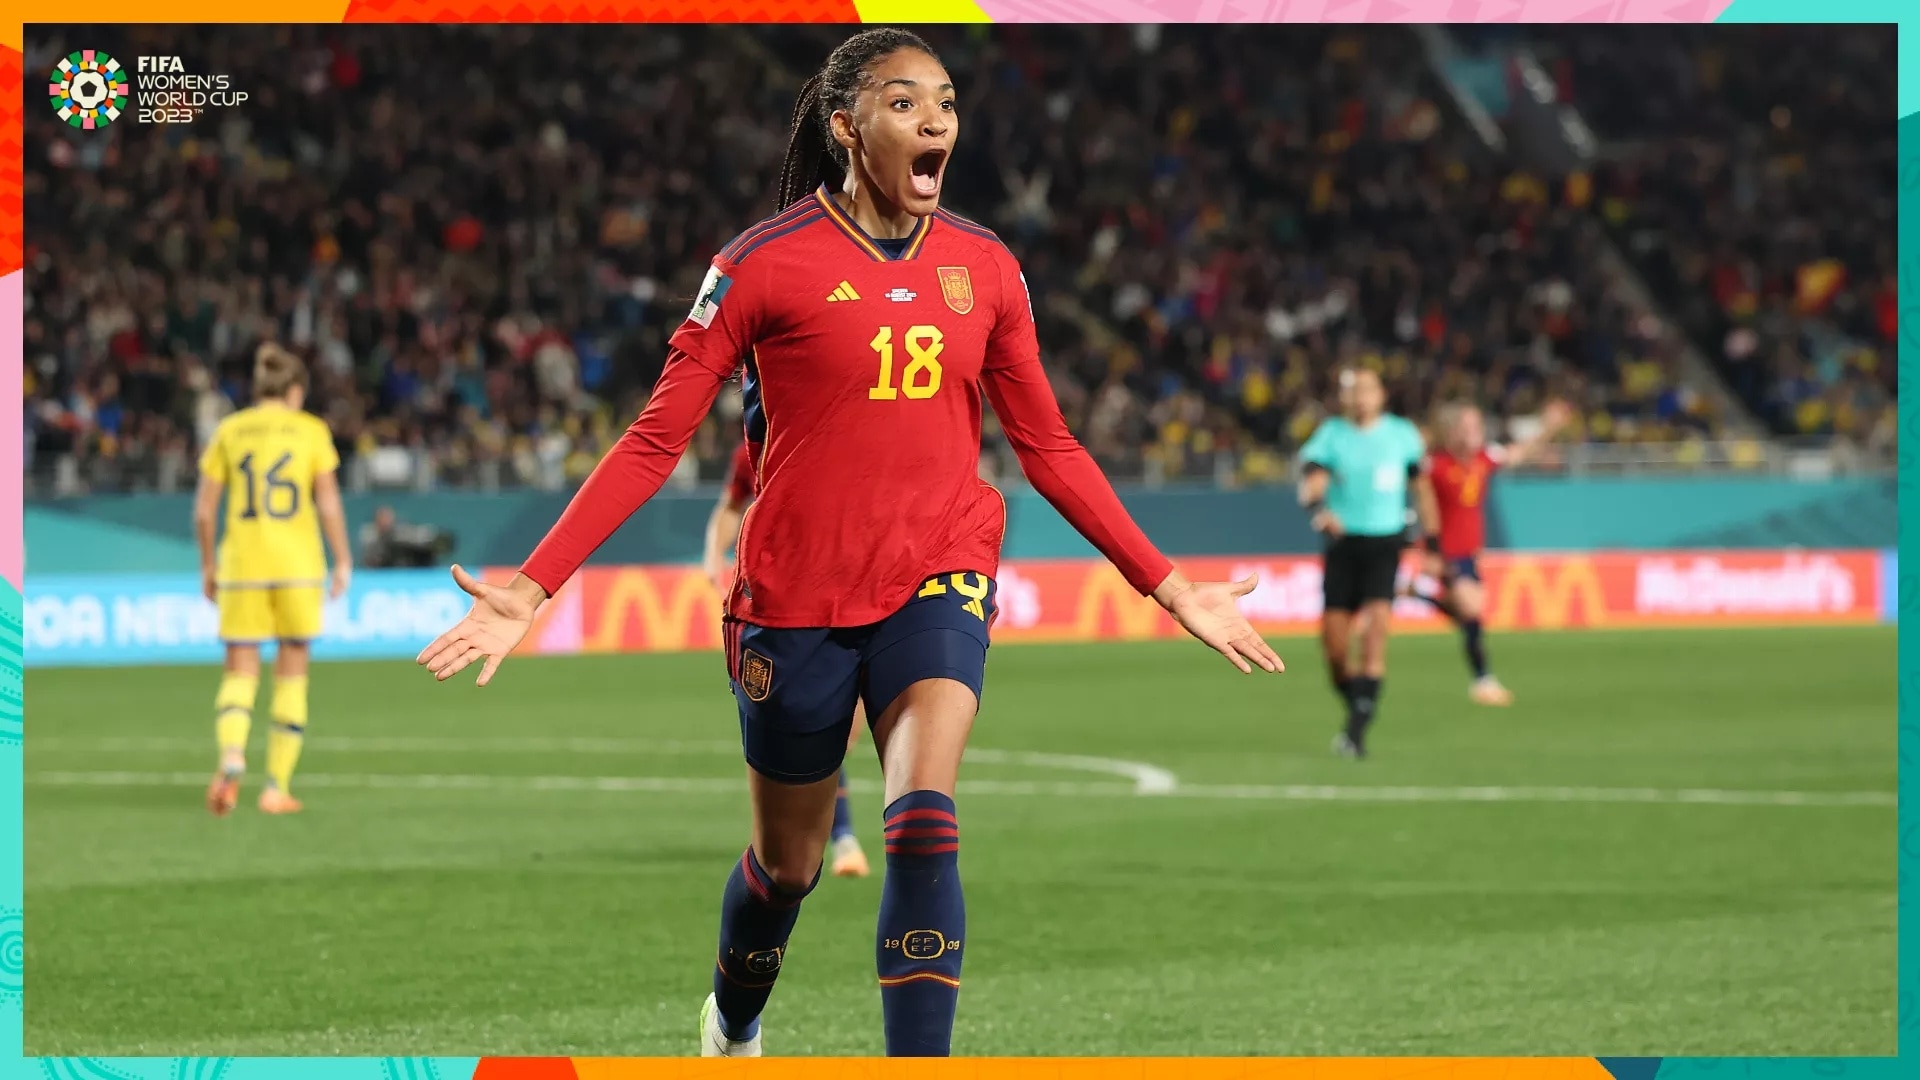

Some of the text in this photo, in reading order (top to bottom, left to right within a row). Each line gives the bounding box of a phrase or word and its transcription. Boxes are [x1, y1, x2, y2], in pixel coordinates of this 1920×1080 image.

[868, 325, 945, 401] 18
[239, 451, 298, 519] 16
[23, 594, 106, 647] OA
[322, 589, 464, 641] LAND
[884, 938, 900, 949] 19
[946, 940, 960, 950] 09
